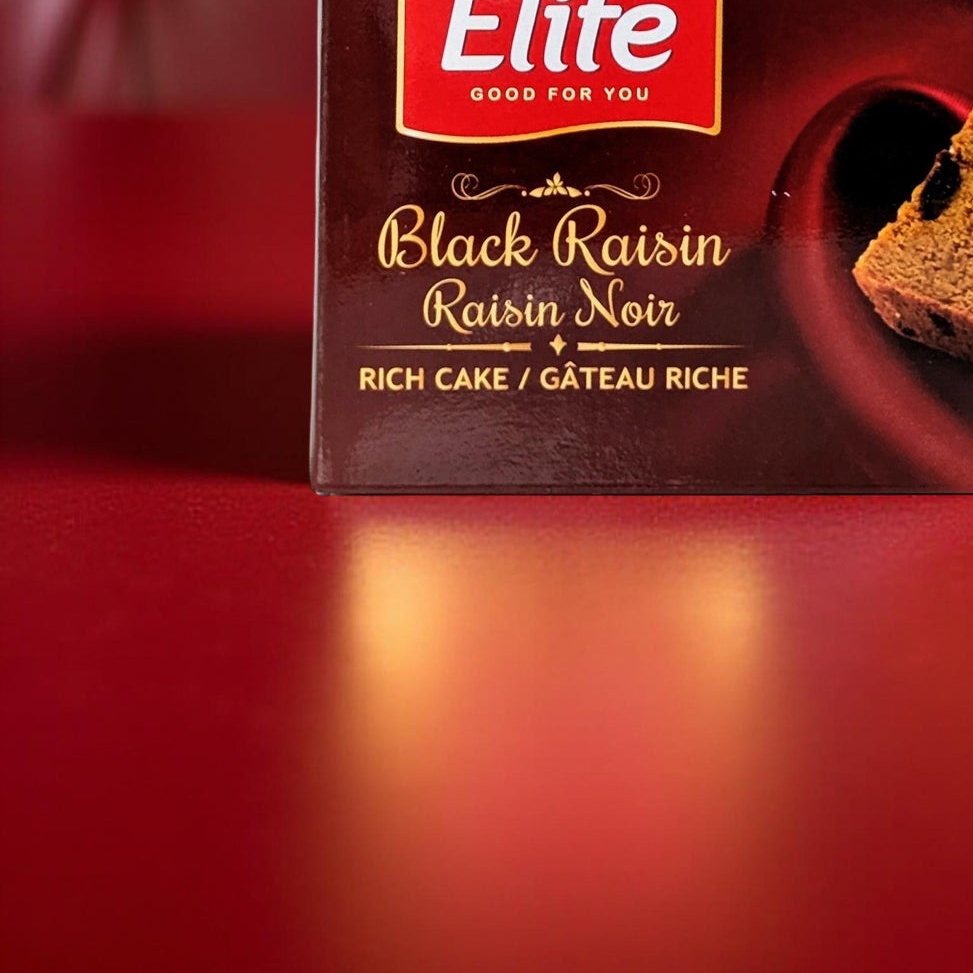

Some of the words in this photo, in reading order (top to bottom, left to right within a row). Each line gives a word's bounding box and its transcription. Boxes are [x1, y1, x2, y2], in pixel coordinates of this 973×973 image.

[470, 86, 537, 102] GOOD
[548, 86, 592, 102] FOR
[603, 86, 649, 102] YOU
[377, 204, 538, 269] Black
[552, 204, 731, 275] Raisin
[422, 278, 564, 334] Raisin
[574, 278, 680, 328] Noir
[359, 367, 425, 390] RICH
[435, 367, 509, 390] CAKE
[517, 367, 531, 391] /
[540, 361, 655, 390] GÂTEAU
[665, 367, 748, 390] RICHE
